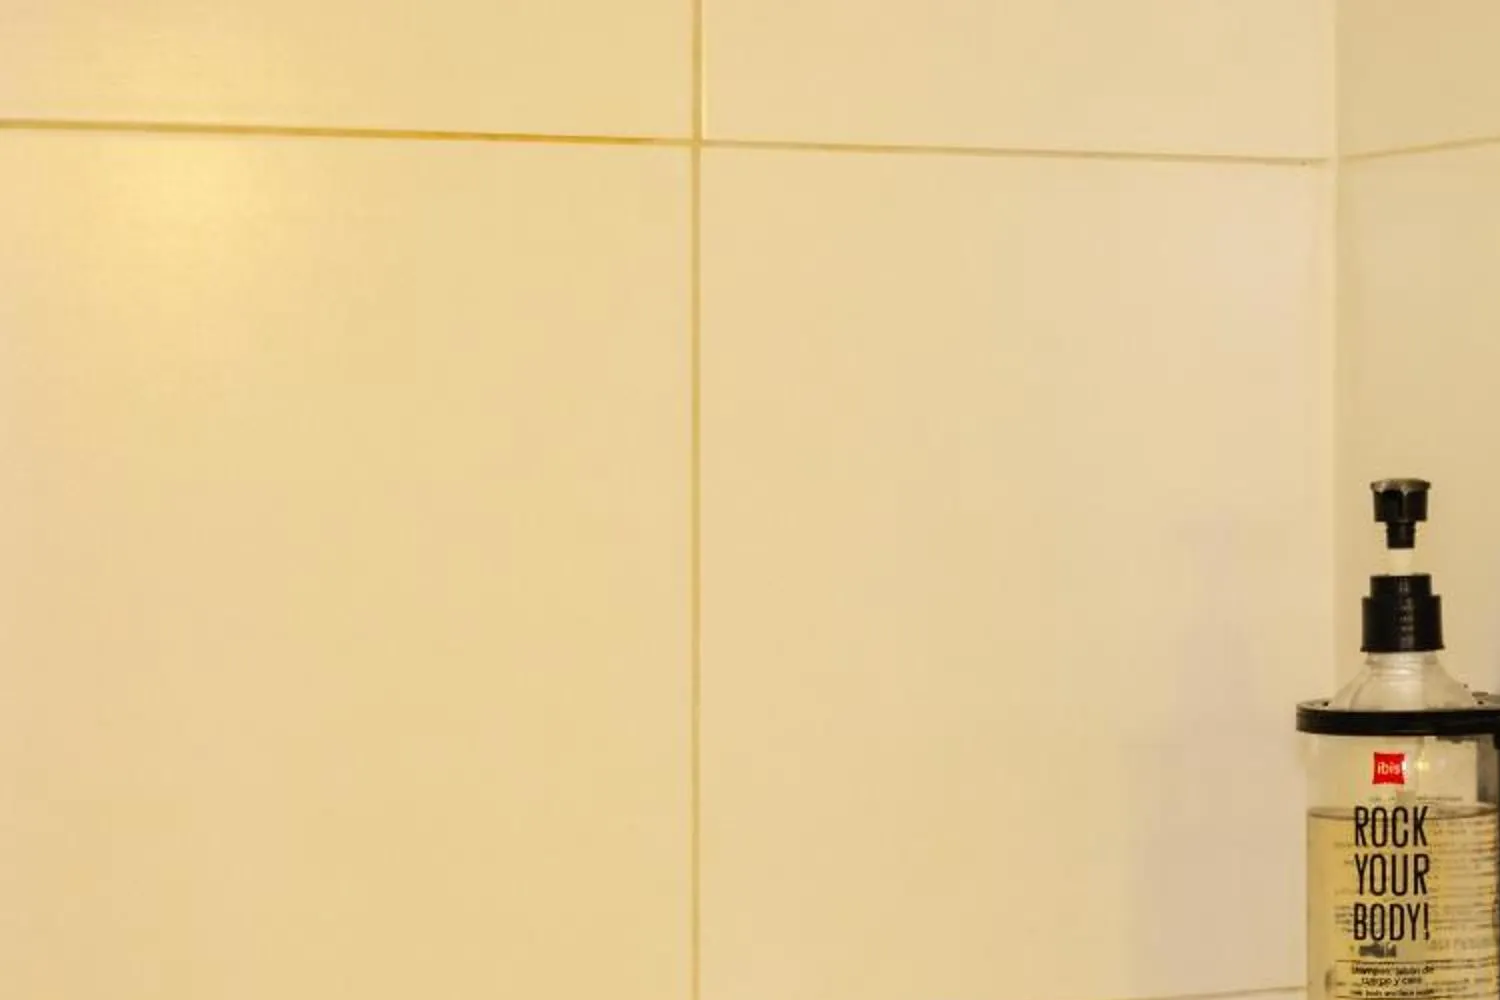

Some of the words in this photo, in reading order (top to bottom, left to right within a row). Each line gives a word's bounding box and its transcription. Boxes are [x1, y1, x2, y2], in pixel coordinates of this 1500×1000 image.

[1377, 761, 1401, 775] ibis
[1354, 805, 1428, 848] ROCK
[1354, 853, 1430, 896] YOUR
[1353, 902, 1430, 941] BODY!
